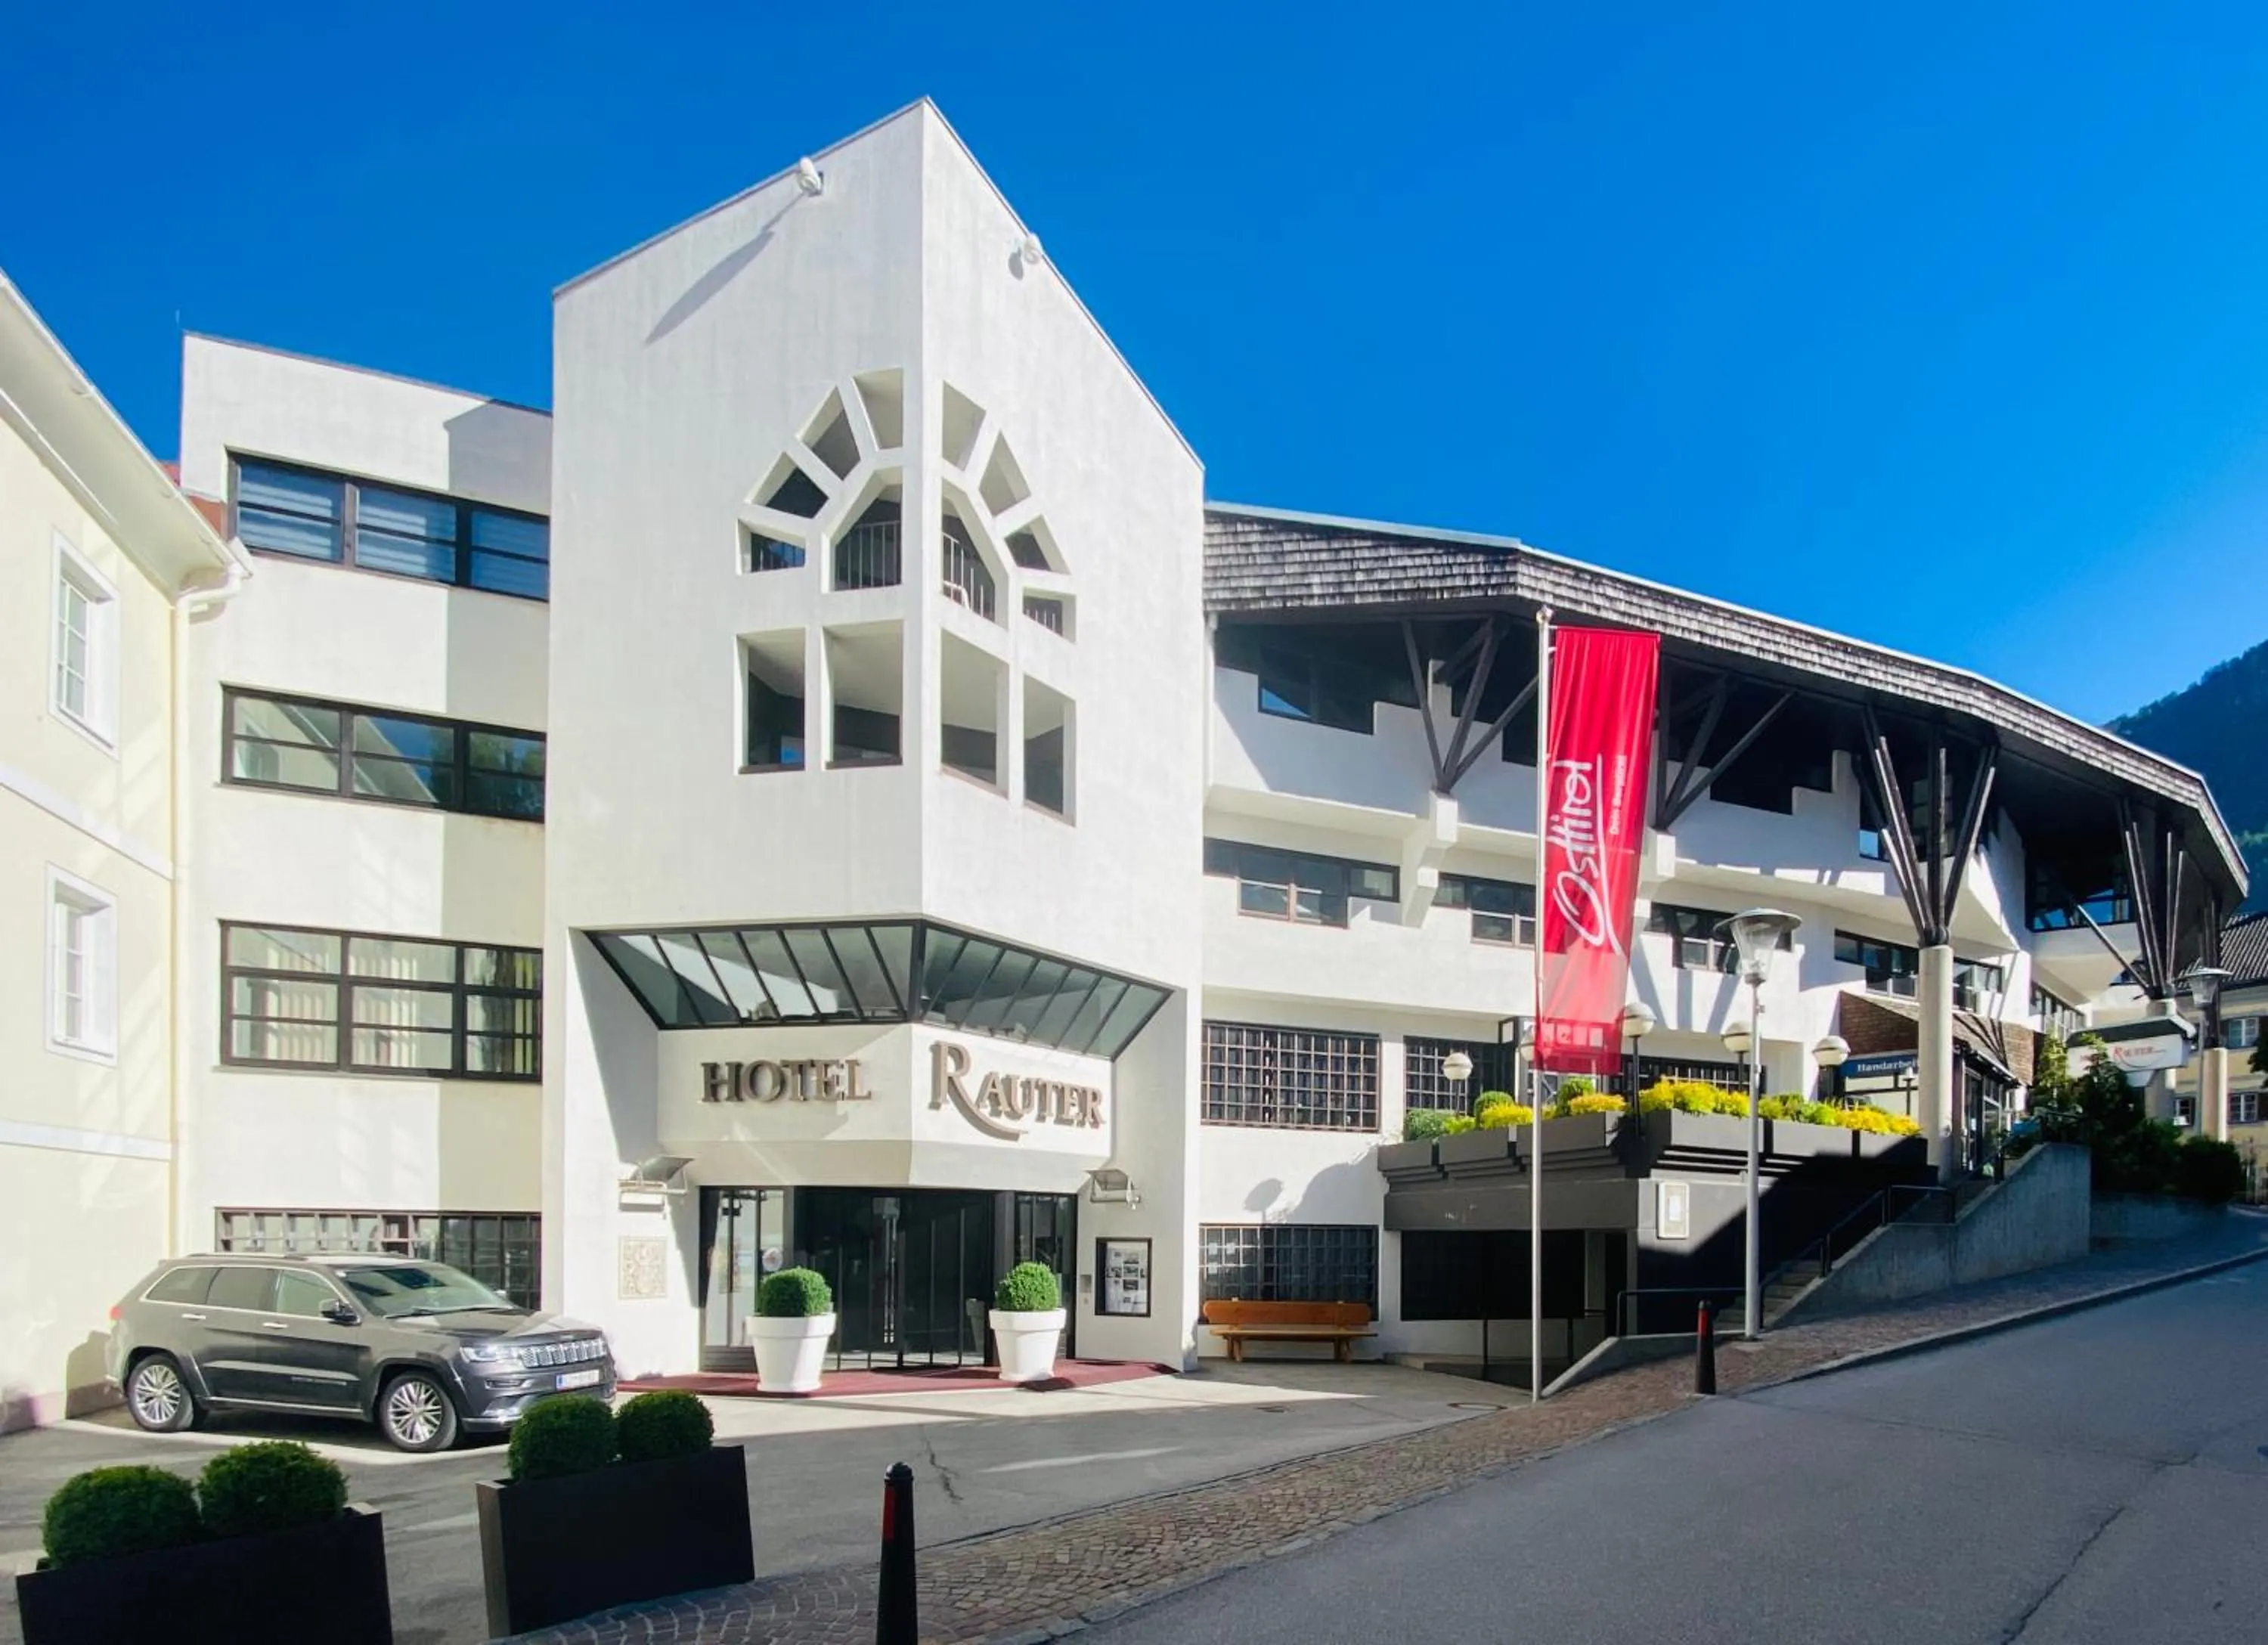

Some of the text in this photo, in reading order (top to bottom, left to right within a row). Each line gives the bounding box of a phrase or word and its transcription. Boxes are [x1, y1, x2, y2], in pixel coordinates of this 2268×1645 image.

[1547, 759, 1604, 946] Osttirol
[702, 1041, 1105, 1141] HOTEL RAUTER
